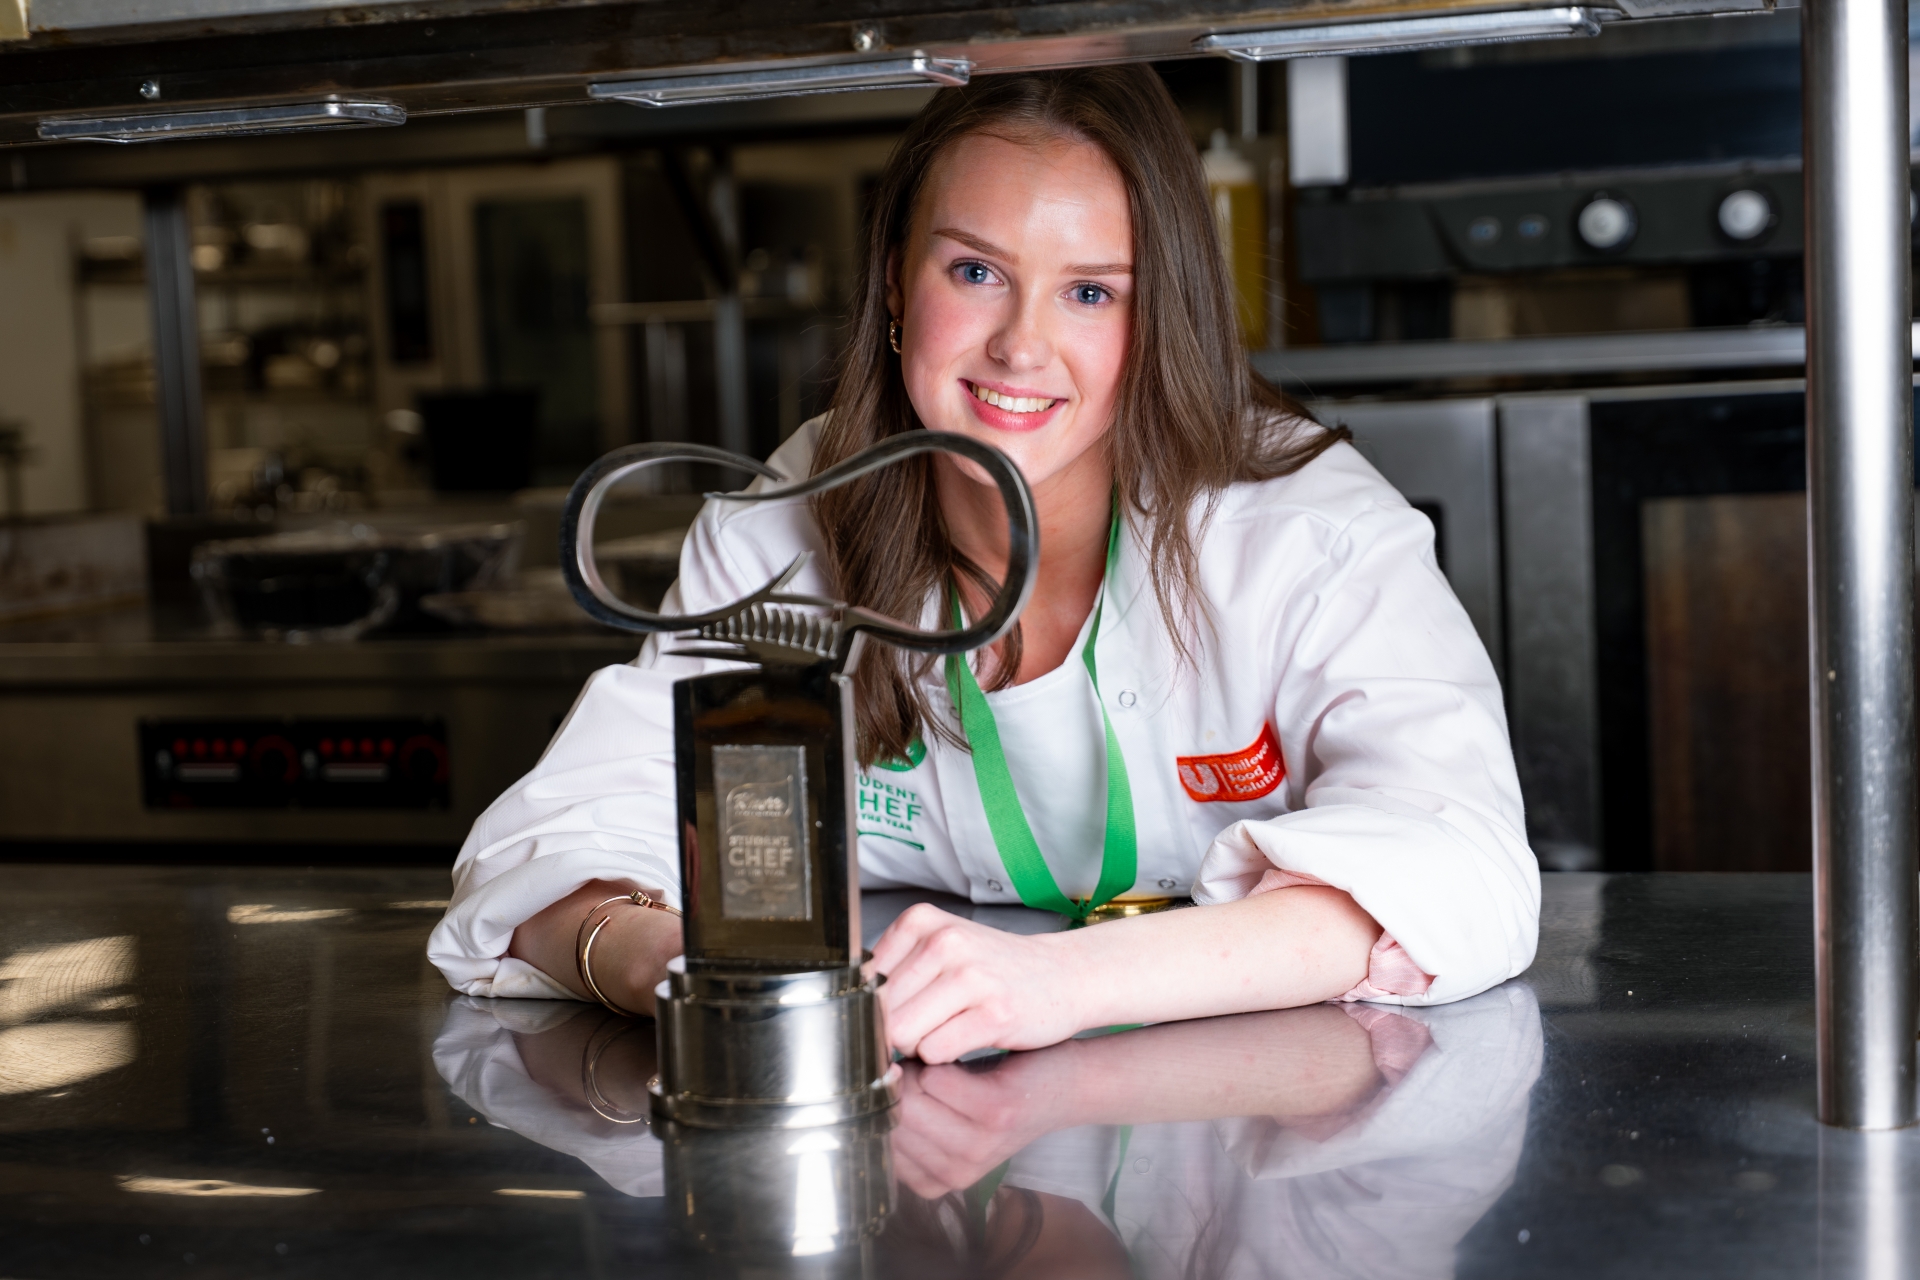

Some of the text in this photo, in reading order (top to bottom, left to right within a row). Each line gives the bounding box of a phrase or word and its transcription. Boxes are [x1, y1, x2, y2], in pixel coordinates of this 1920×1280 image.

[1223, 741, 1269, 772] Unilever
[858, 774, 917, 802] UDENT
[1228, 765, 1264, 783] Food
[1234, 758, 1281, 794] Solution
[859, 789, 922, 822] HEF
[861, 813, 913, 832] THE YEAR
[728, 847, 794, 869] CHEF
